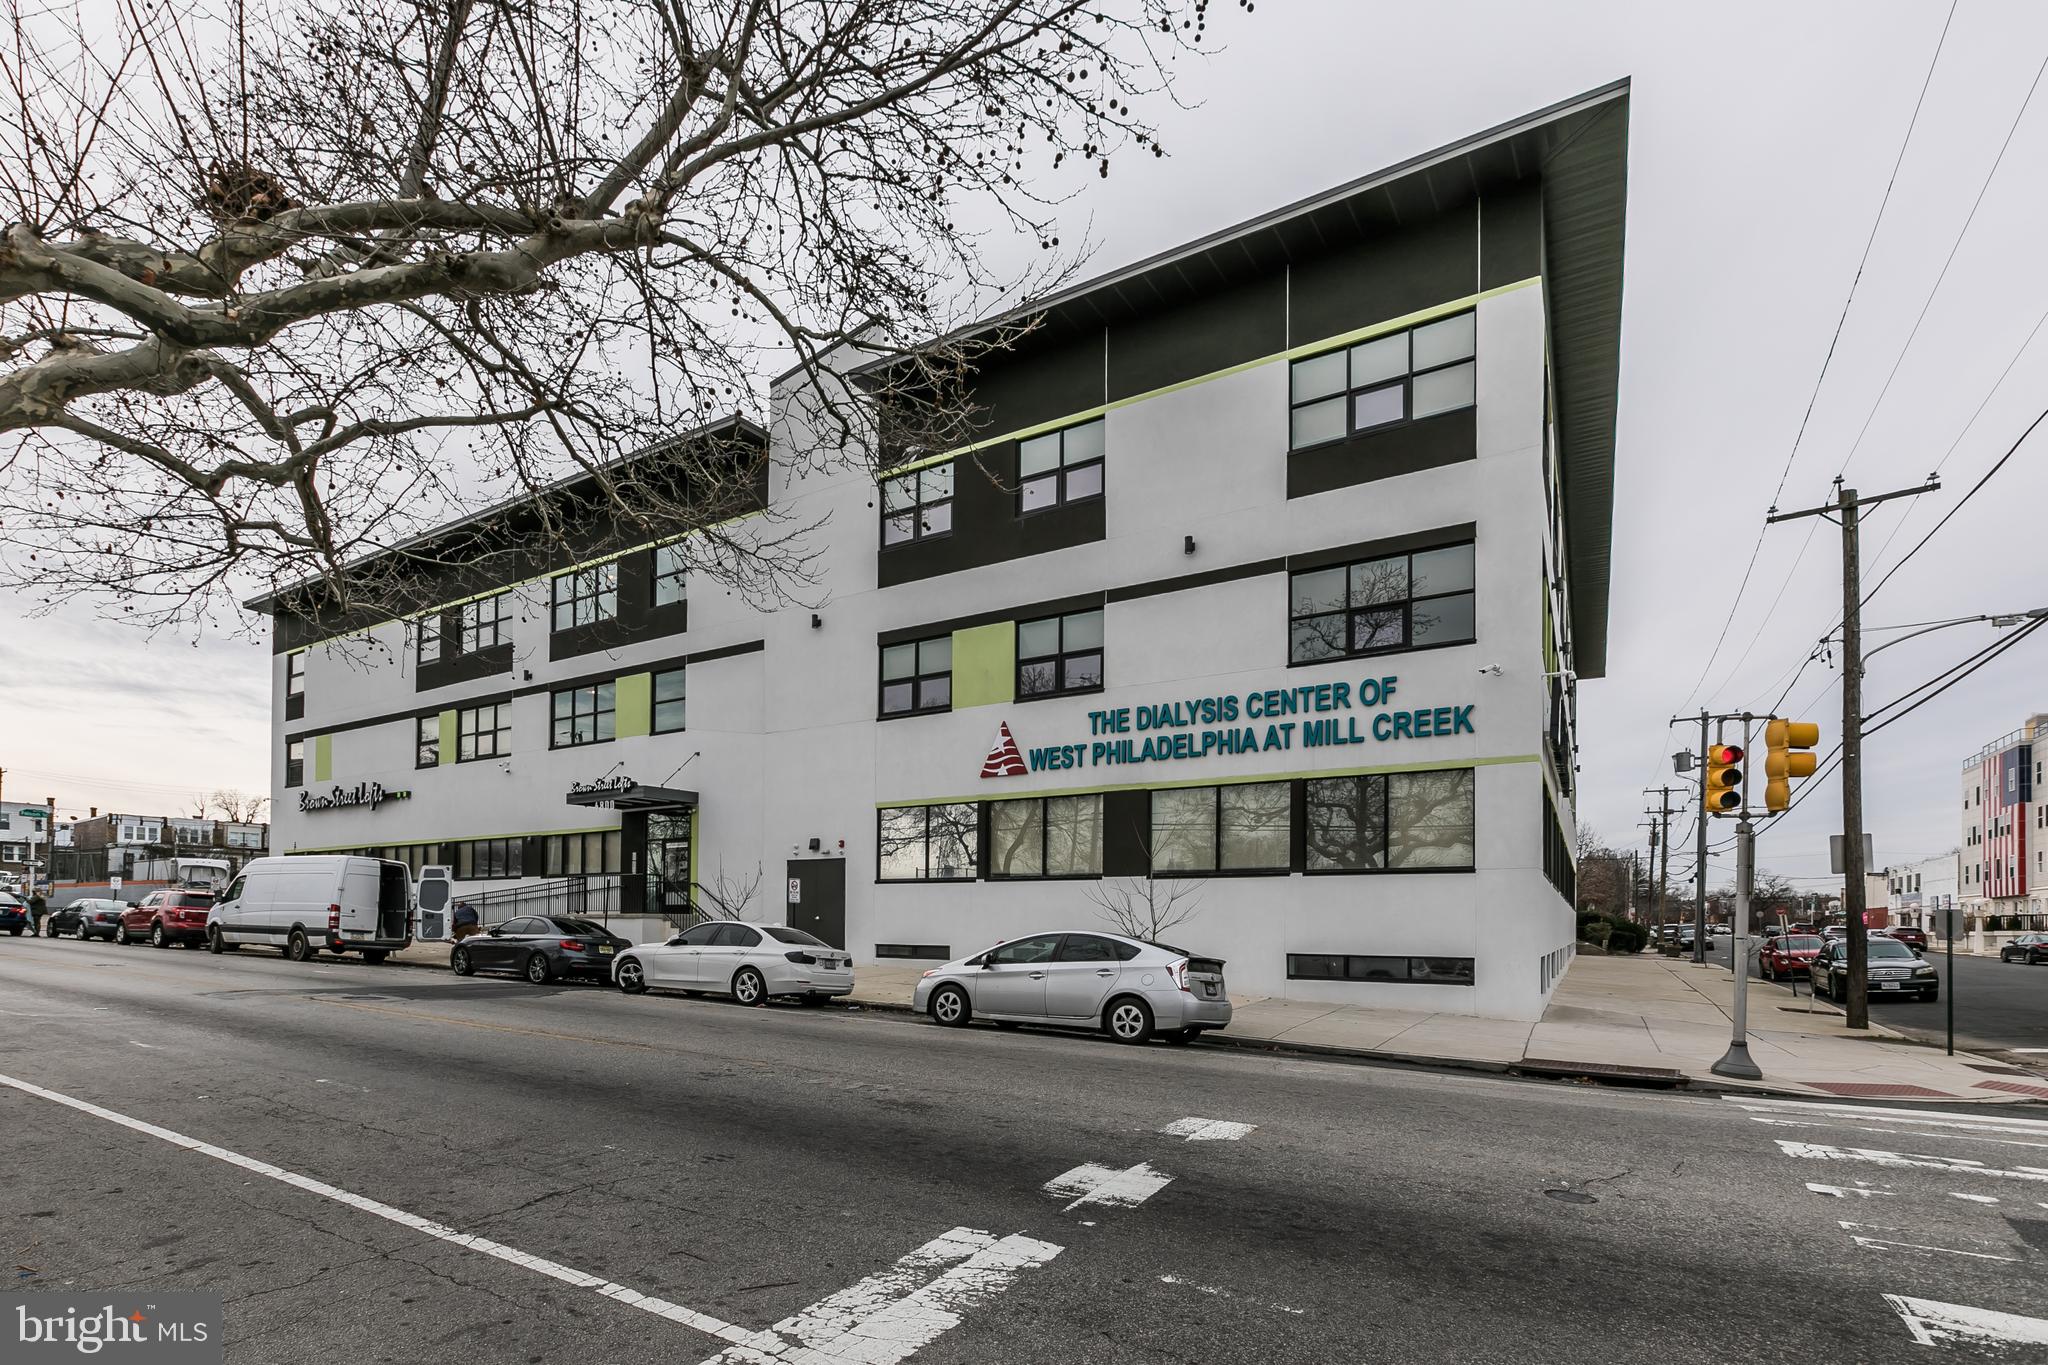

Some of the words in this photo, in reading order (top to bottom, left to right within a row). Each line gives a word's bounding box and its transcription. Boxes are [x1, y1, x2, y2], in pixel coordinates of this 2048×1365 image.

[1088, 706, 1130, 735] THE
[1136, 694, 1239, 731] DIALYSIS
[1245, 682, 1351, 720] CENTER
[1359, 676, 1398, 706] OF
[1029, 743, 1087, 772] WEST
[1092, 728, 1258, 767] PHILADELPHIA
[1263, 722, 1296, 751] AT
[1303, 717, 1365, 748] MILL
[1372, 704, 1475, 739] CREEK
[299, 790, 329, 812] Brown
[330, 785, 360, 807] Street
[360, 781, 385, 811] Lofts
[571, 781, 593, 794] Brown
[593, 778, 613, 791] Street
[613, 776, 632, 793] Lofts
